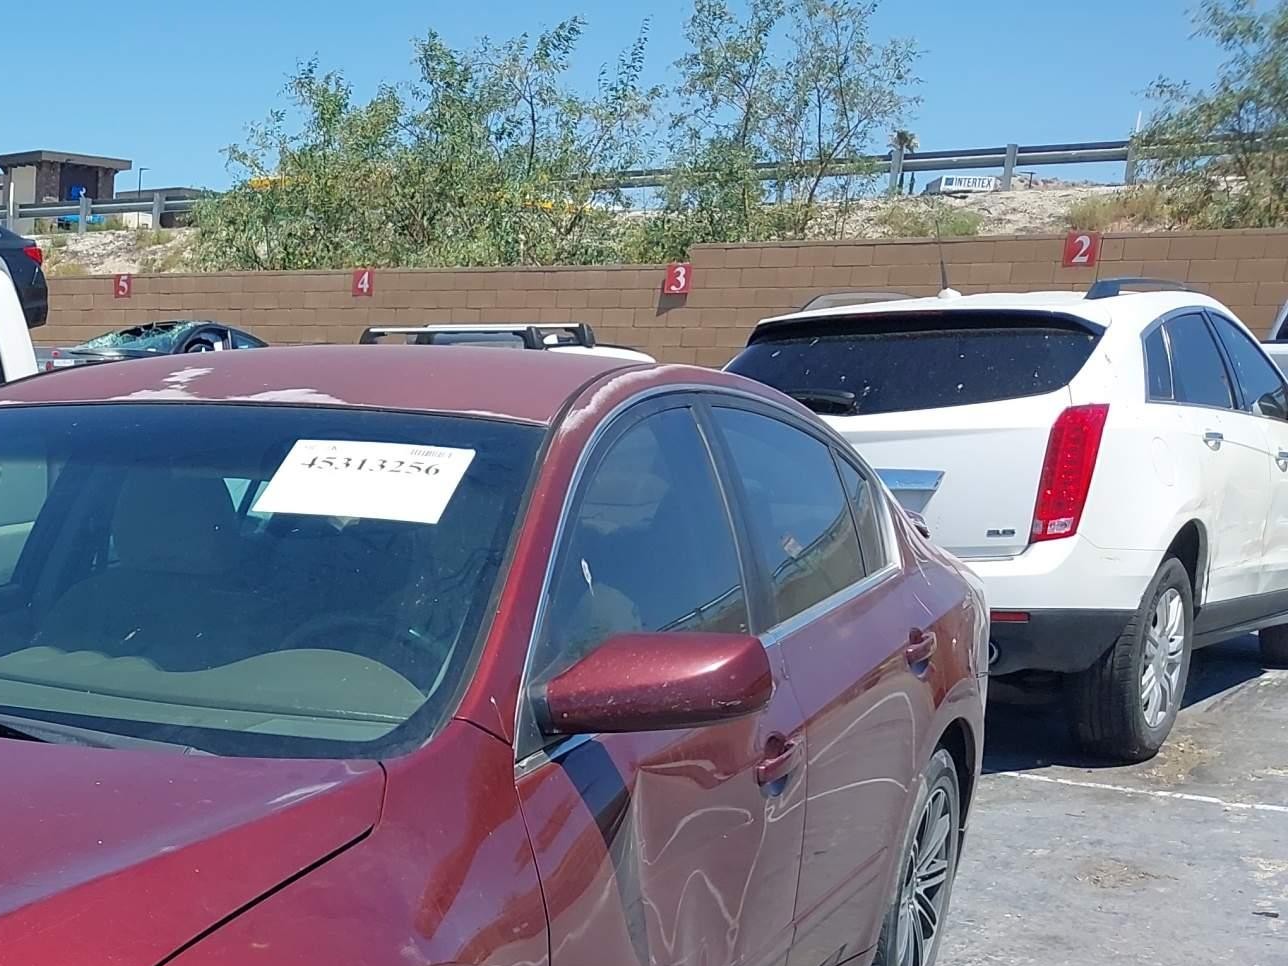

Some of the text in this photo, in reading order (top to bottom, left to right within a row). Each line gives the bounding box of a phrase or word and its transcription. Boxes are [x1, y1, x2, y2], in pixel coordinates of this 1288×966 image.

[954, 177, 993, 188] INTERTEX
[1071, 235, 1091, 263] 2
[118, 275, 129, 296] 5
[357, 271, 370, 293] 4
[670, 266, 687, 291] 3
[300, 455, 441, 477] 45313256
